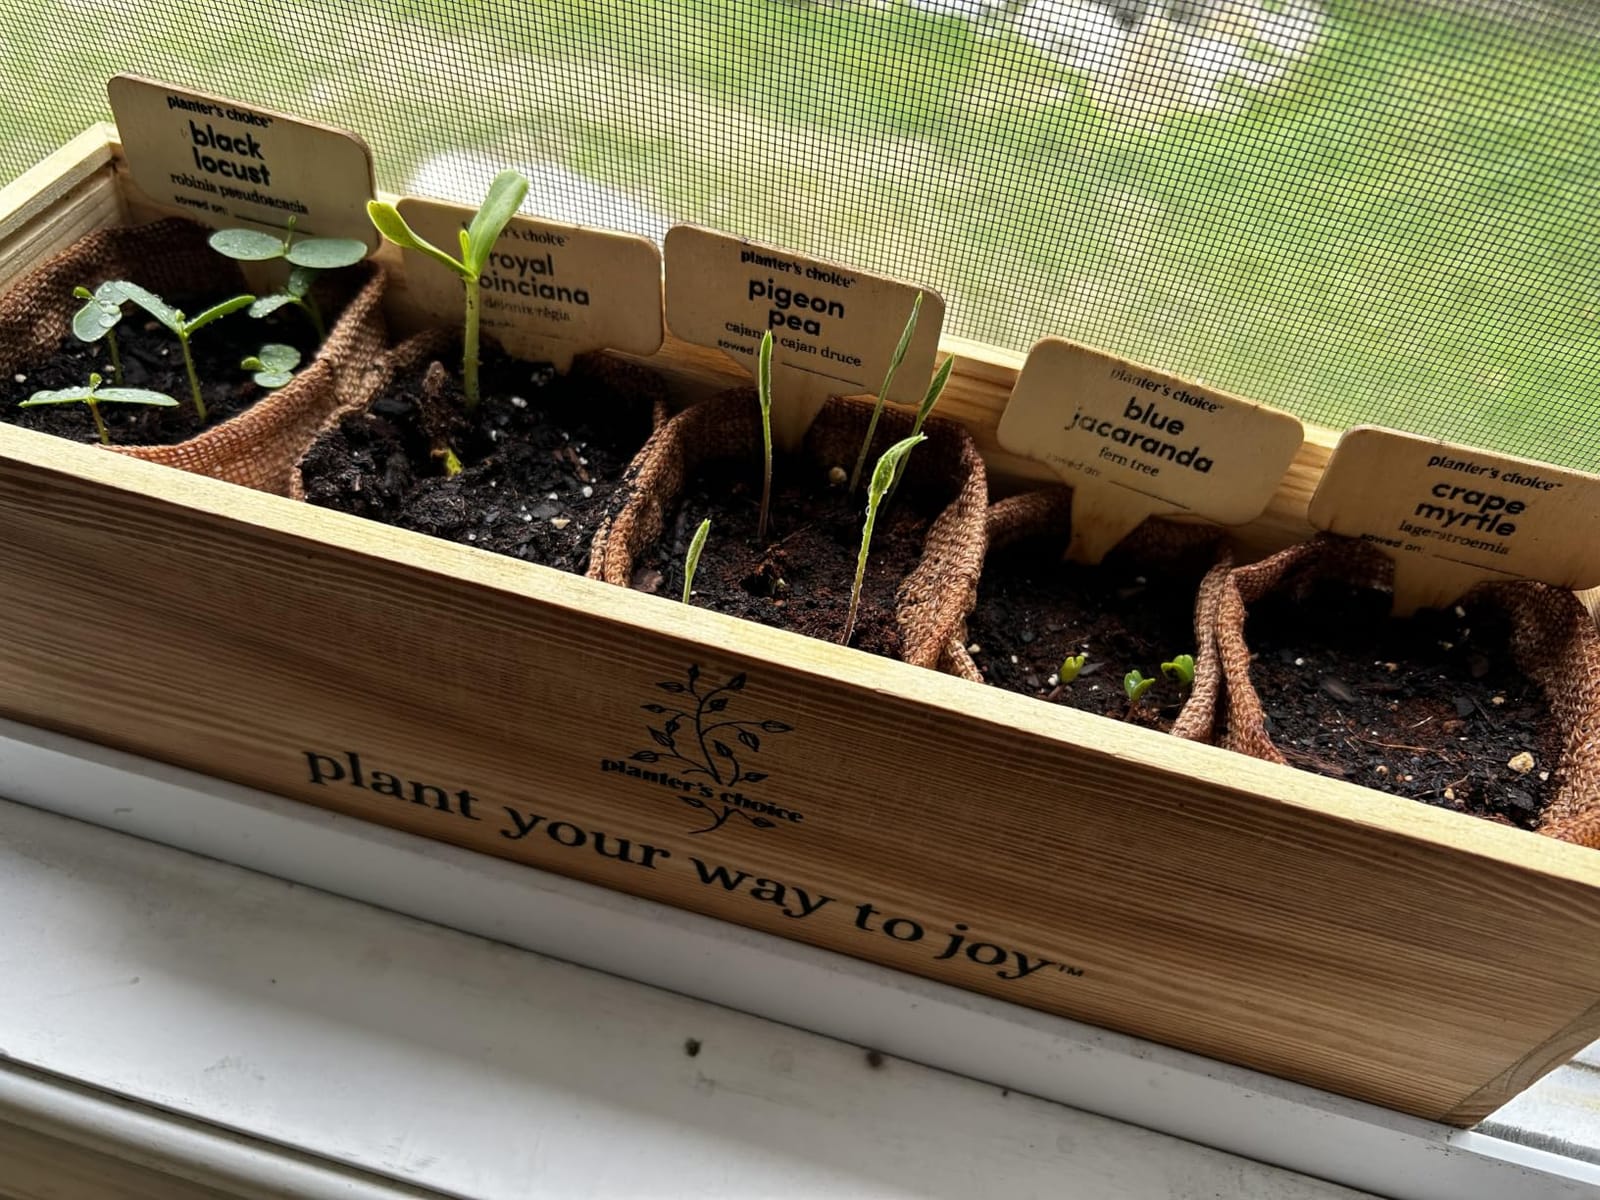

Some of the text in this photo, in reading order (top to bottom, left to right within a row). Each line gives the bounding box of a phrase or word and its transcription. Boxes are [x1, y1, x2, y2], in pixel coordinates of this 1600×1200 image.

[167, 95, 224, 118] planter's
[189, 120, 265, 161] black
[170, 172, 218, 194] robinia
[193, 146, 271, 186] locust
[489, 251, 555, 278] royal
[741, 250, 802, 276] planter's
[461, 269, 591, 307] oinciana
[748, 278, 845, 319] pigeon
[768, 308, 822, 338] pea
[718, 338, 754, 356] sowed
[725, 321, 862, 367] cajans cajan druce
[1111, 367, 1171, 397] planter's
[1123, 396, 1185, 437] blue
[1064, 406, 1215, 475] jacaranda
[1099, 446, 1160, 477] fern tree
[1427, 455, 1500, 480] planter's
[1431, 482, 1527, 516] crape
[1414, 501, 1517, 538] myrtle
[1360, 533, 1402, 548] sowed
[1398, 520, 1511, 556] lagerstroemia
[601, 758, 804, 824] planter's choice
[302, 750, 482, 822] plant
[500, 804, 671, 871] your
[689, 856, 837, 919] way
[855, 903, 924, 943] to
